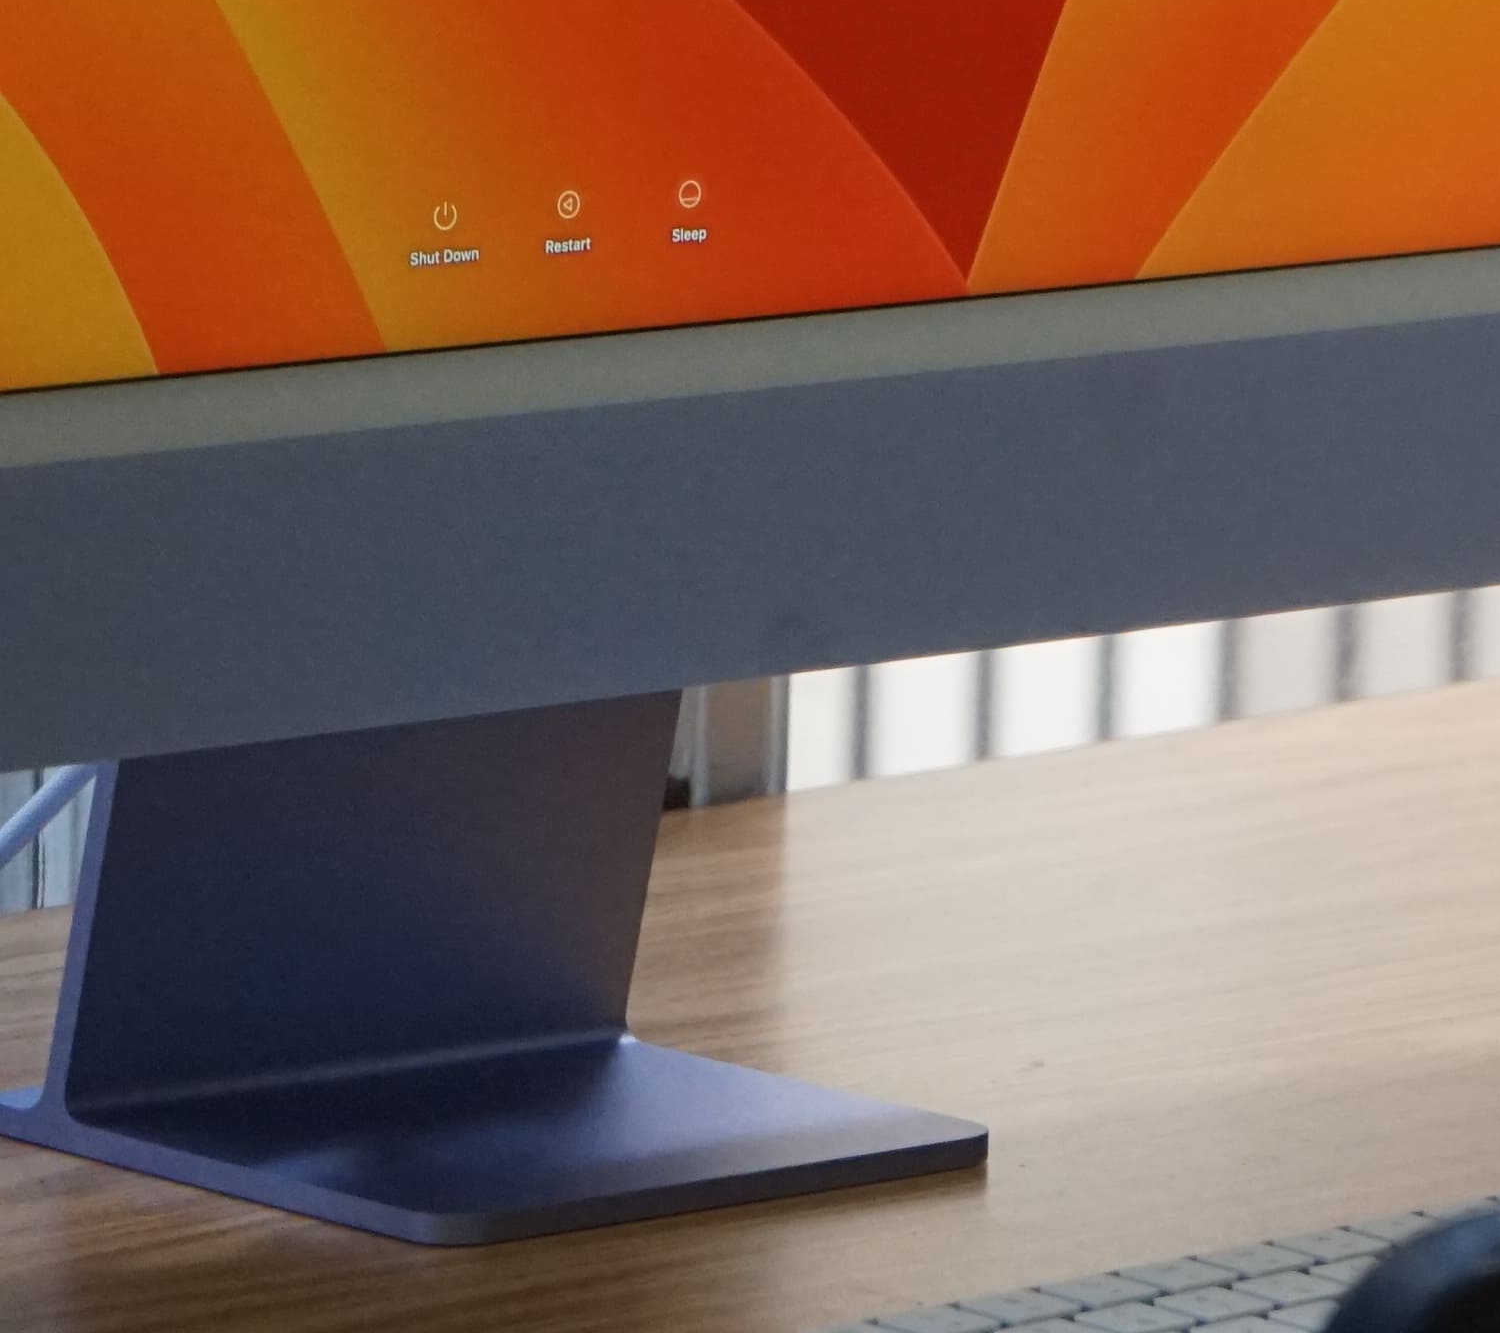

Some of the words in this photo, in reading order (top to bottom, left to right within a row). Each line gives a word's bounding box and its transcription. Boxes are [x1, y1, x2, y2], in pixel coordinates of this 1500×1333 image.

[672, 228, 707, 244] Sleep
[546, 237, 591, 253] Restart
[410, 251, 440, 266] Shut
[444, 248, 479, 264] Down
